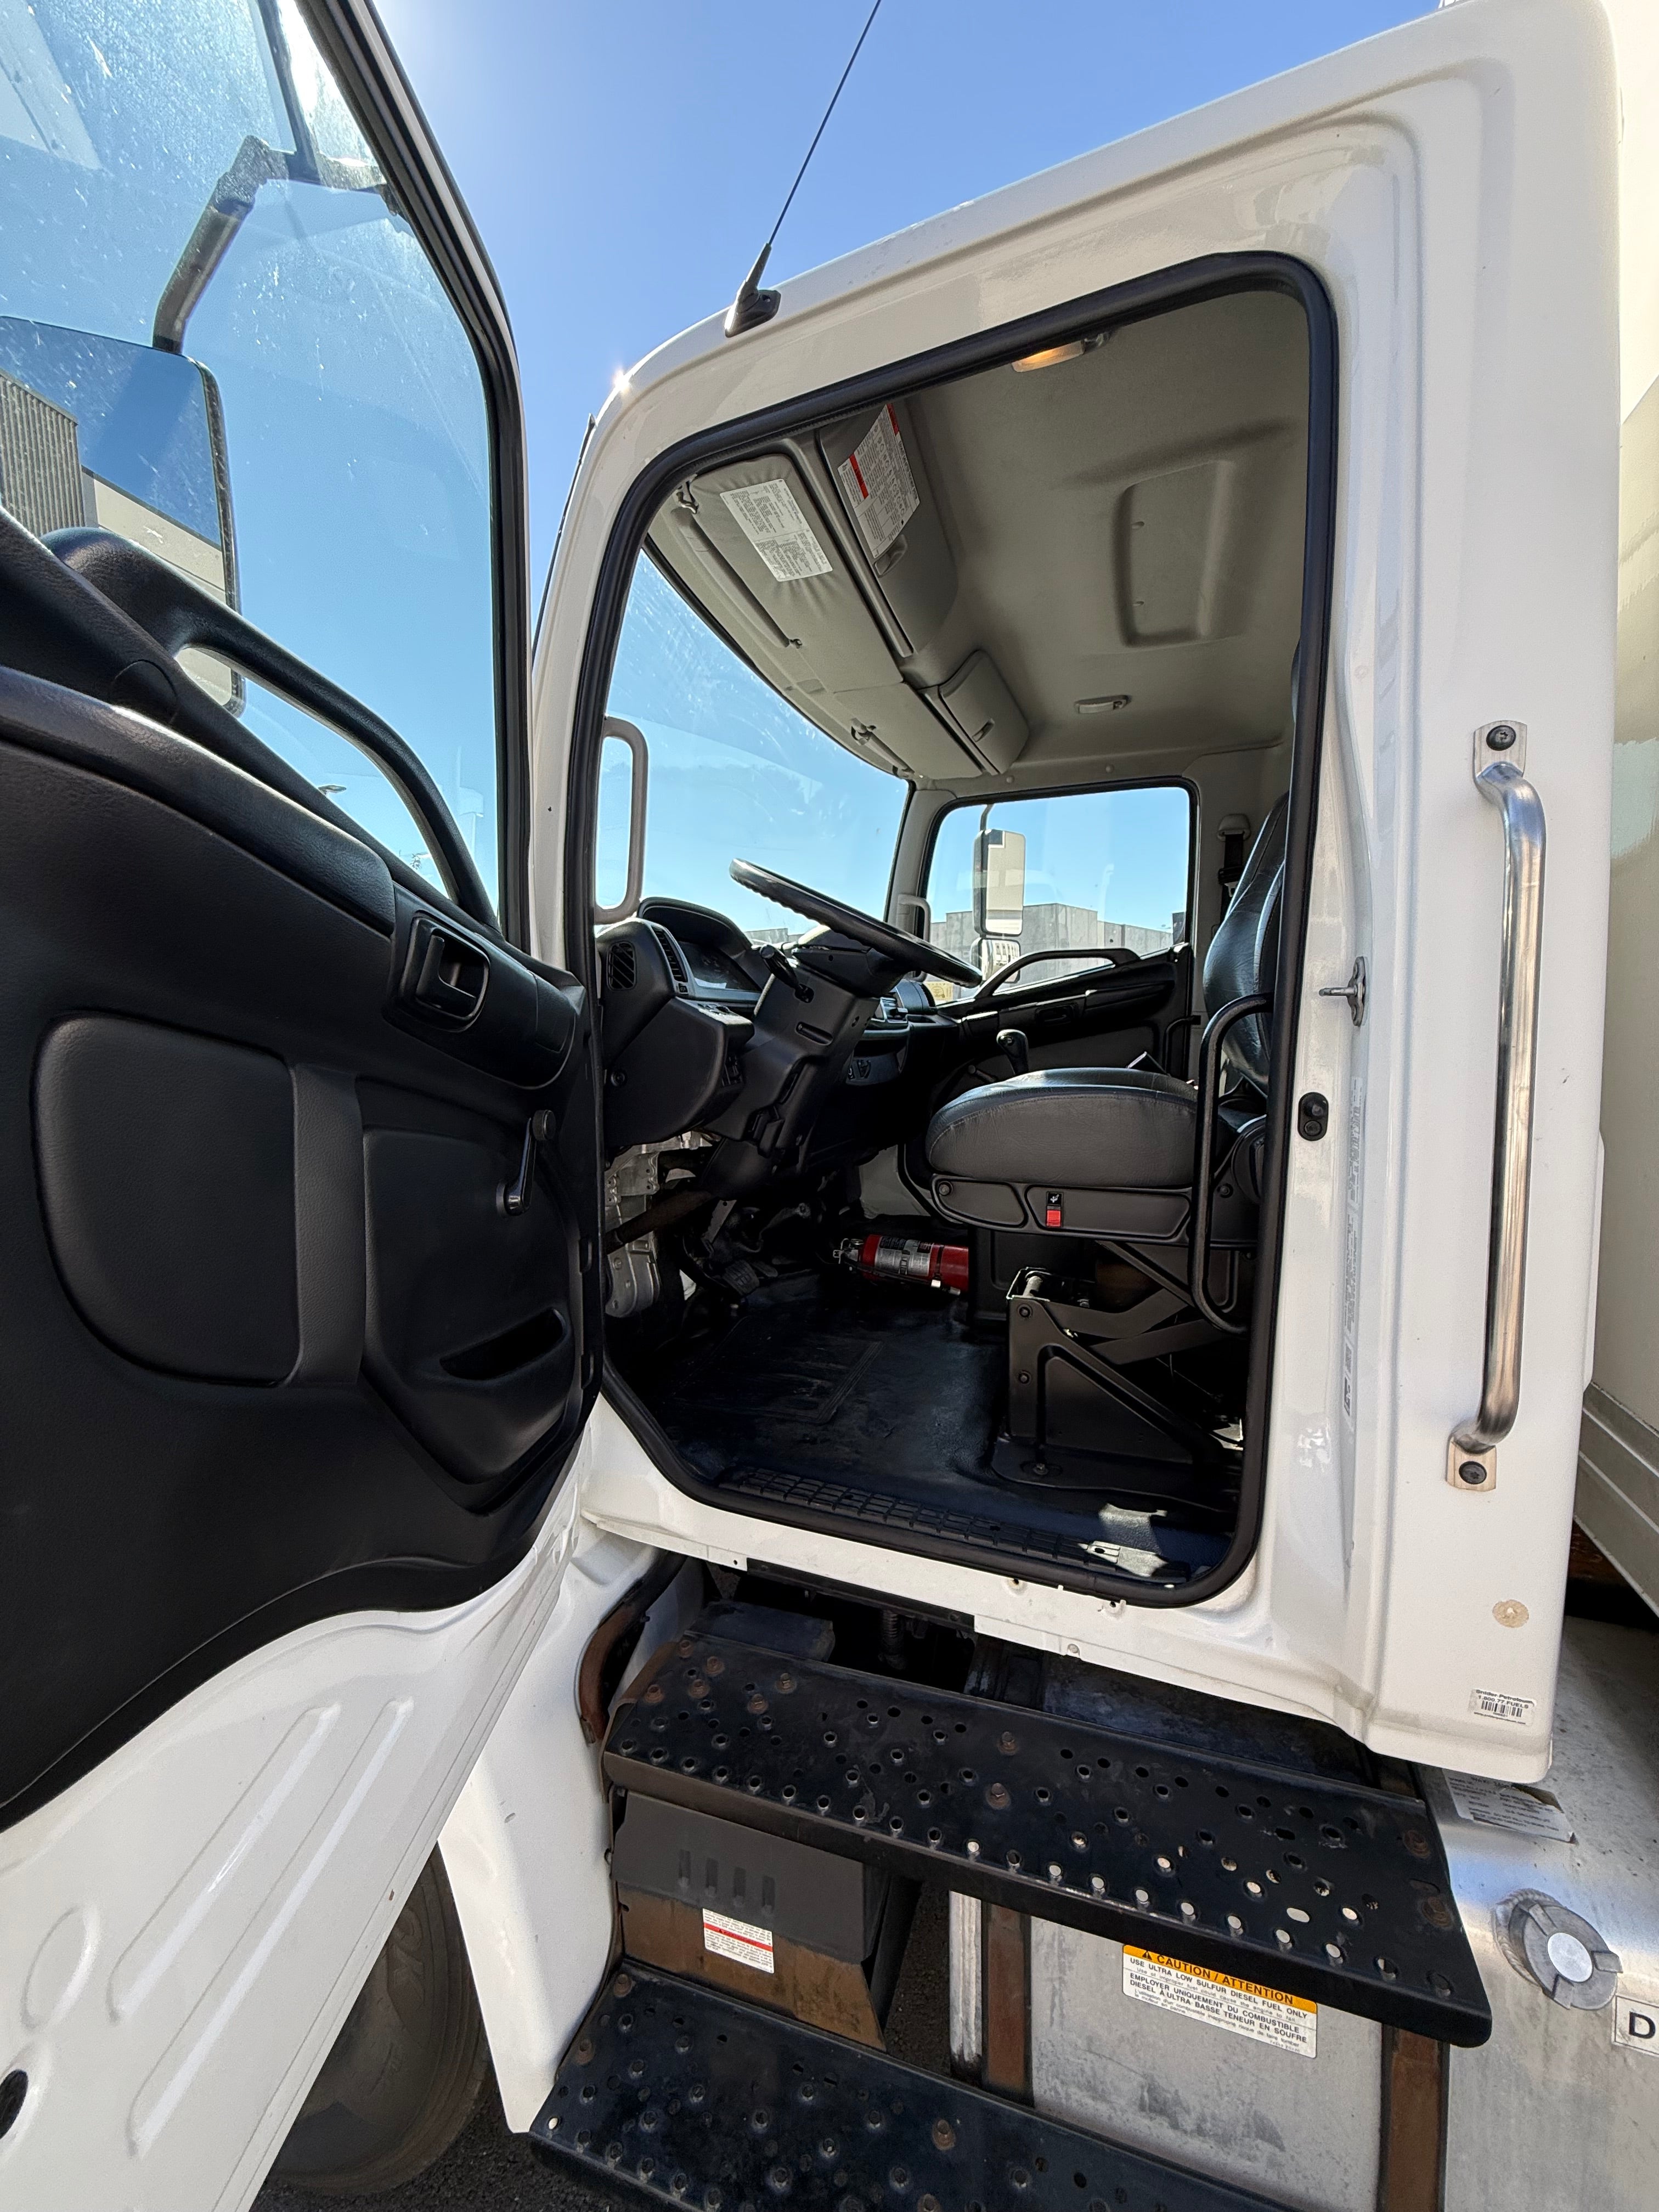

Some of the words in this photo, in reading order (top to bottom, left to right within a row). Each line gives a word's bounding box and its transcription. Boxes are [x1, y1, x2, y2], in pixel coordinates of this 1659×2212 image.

[1475, 1689, 1498, 1697] Snider
[1130, 1957, 1144, 1967] USE
[1149, 1963, 1172, 1976] ULTRA
[1176, 1972, 1193, 1983] LOW
[1197, 1979, 1227, 1994] SULFUR
[1231, 1990, 1258, 2004] DIESEL
[1262, 2000, 1282, 2012] FUEL
[1286, 2008, 1307, 2018] ONLY
[1130, 1973, 1170, 1991] EMPLOYER
[1174, 1987, 1223, 2008] UNIQUEMENT
[1227, 2005, 1238, 2013] DU
[1243, 2010, 1299, 2033] COMBUSTIBLE
[1156, 1955, 1211, 1979] CAUTION
[1214, 1973, 1218, 1981] /
[1222, 1976, 1293, 2004] ATTENTION
[1159, 1975, 1183, 1985] improper
[1253, 2006, 1273, 2015] engine
[1130, 1979, 1156, 1994] DIESEL
[1167, 1991, 1191, 2005] ULTRA
[1195, 2001, 1221, 2015] BASSE
[1223, 2011, 1255, 2027] TENEUR
[1259, 2022, 1270, 2031] EN
[1274, 2027, 1307, 2043] SOUFRE
[1629, 2011, 1656, 2039] D
